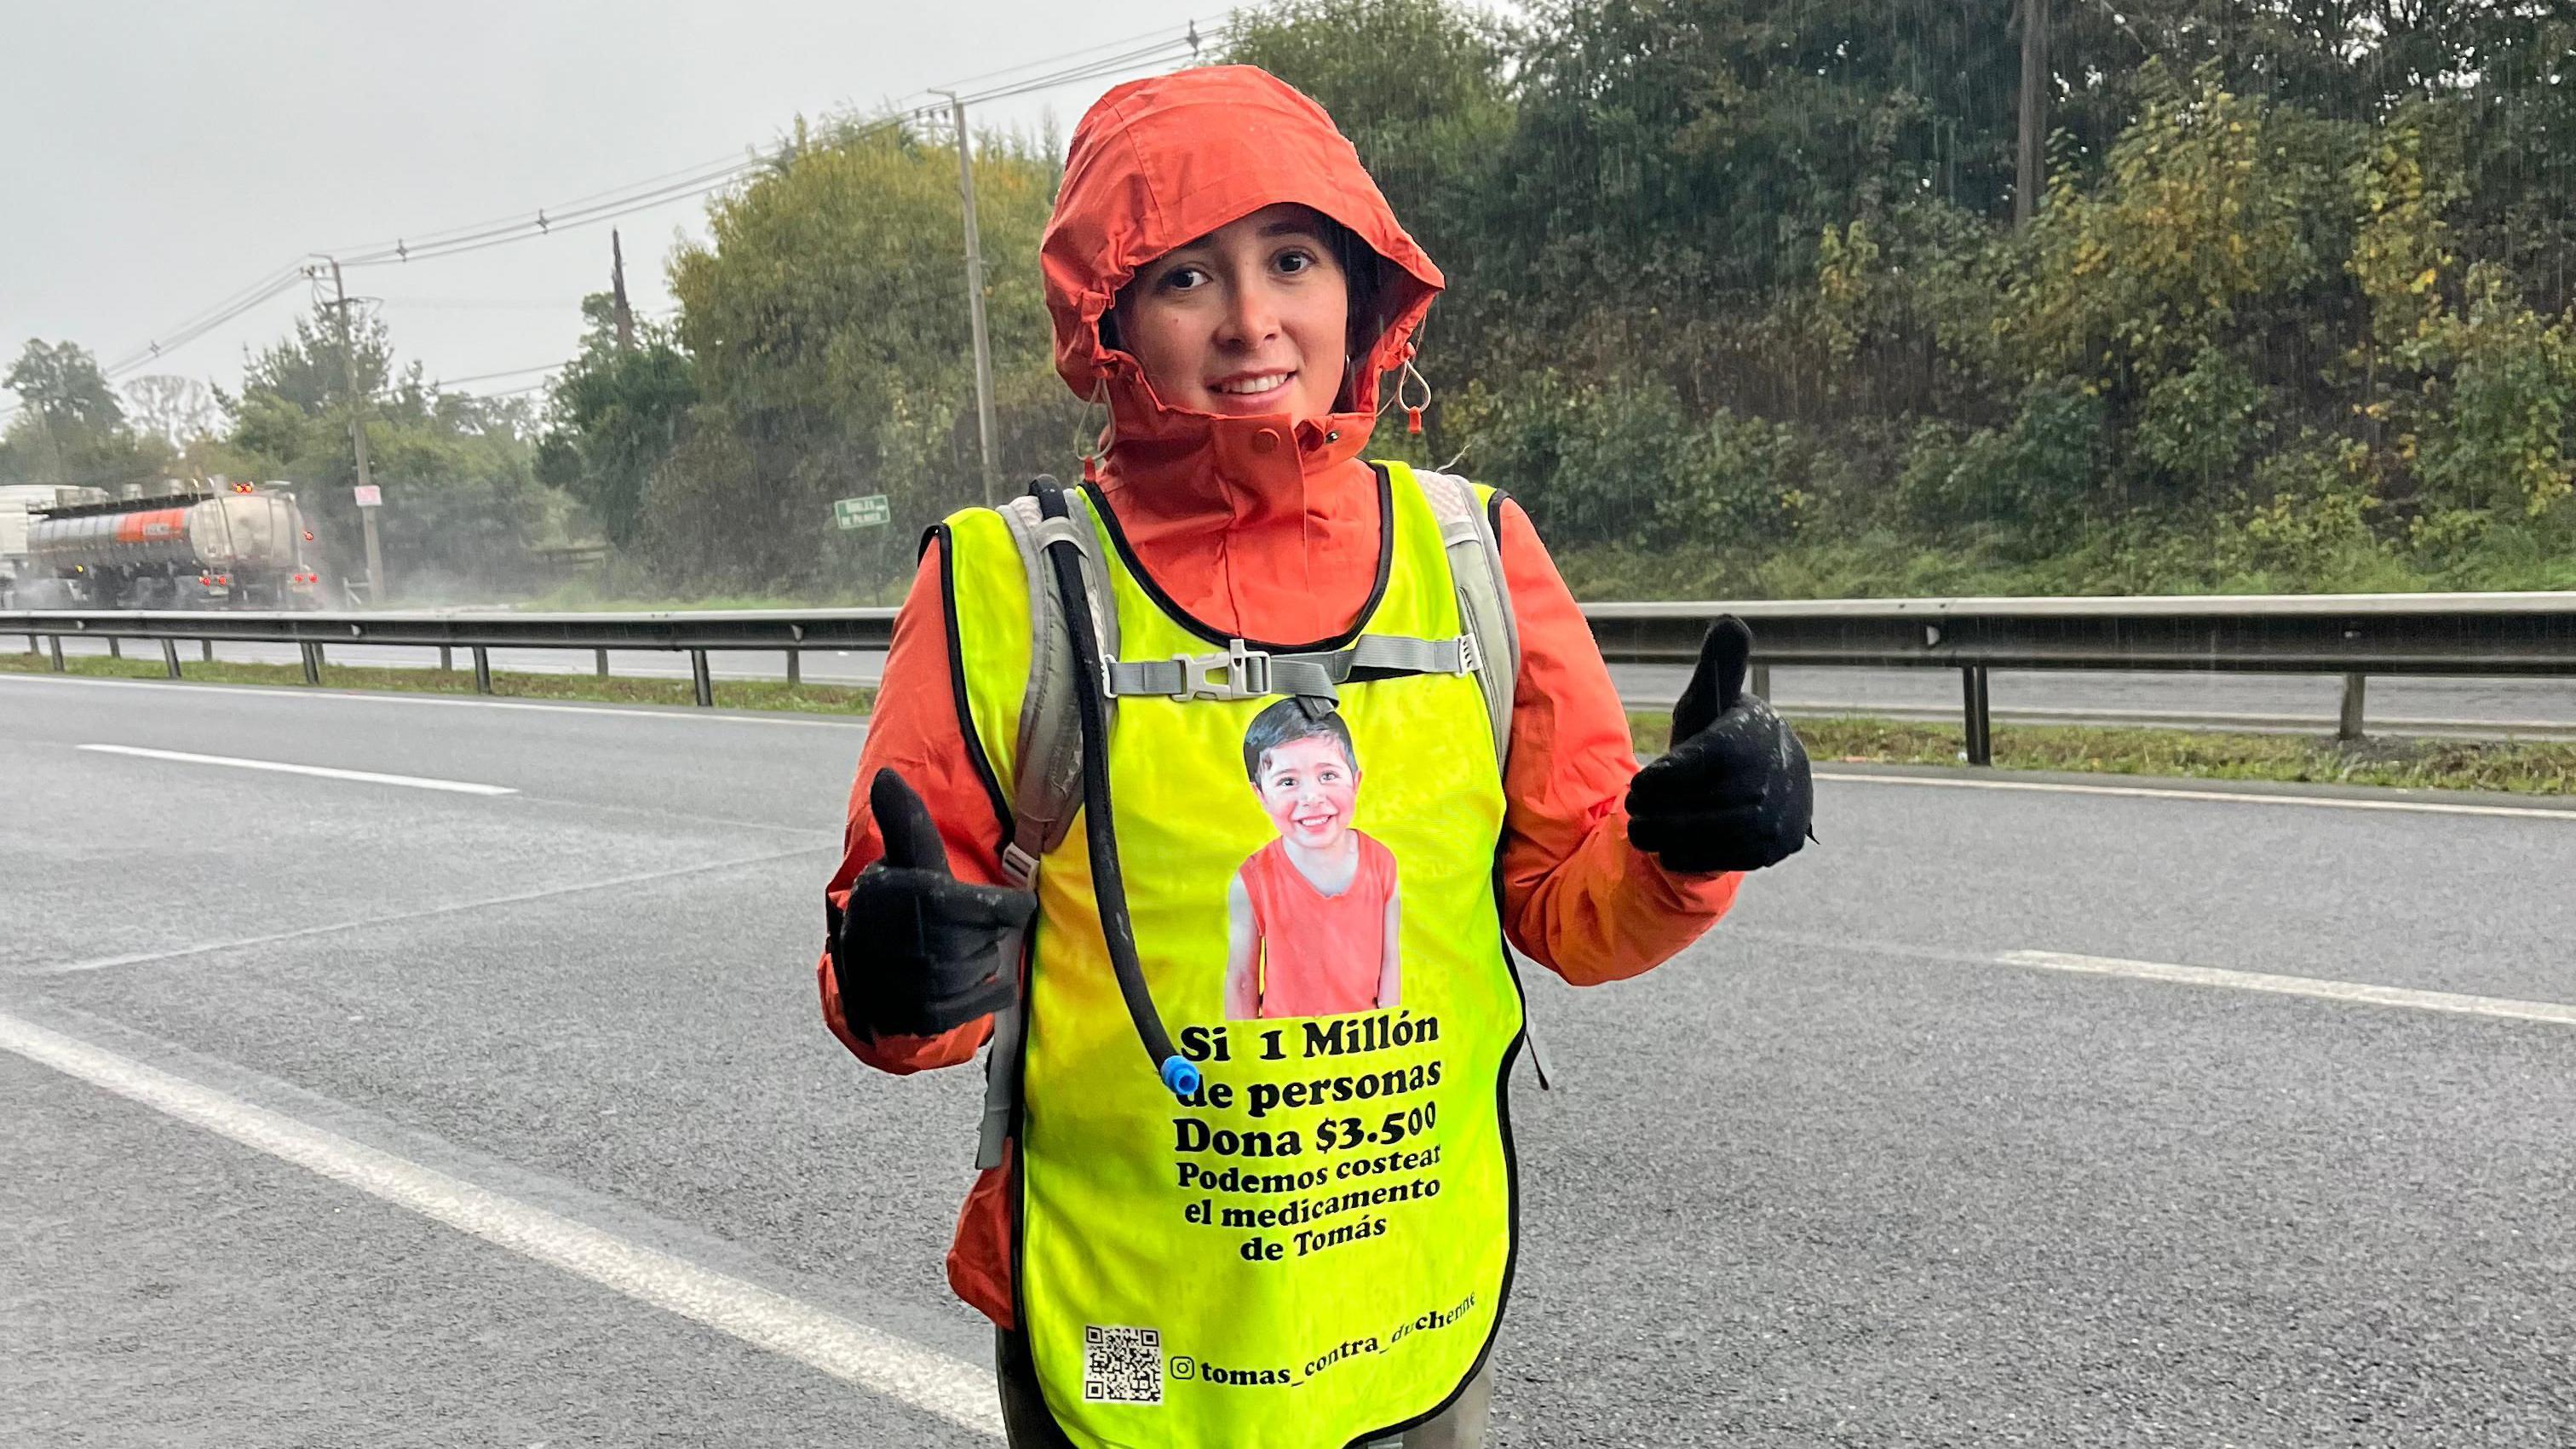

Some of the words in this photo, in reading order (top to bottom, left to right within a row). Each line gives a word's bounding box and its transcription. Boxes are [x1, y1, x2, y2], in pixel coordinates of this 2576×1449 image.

[1181, 1026, 1232, 1062] Si
[1259, 1030, 1287, 1061] 1
[1302, 1009, 1439, 1058] Millón
[1246, 1061, 1442, 1118] personas
[1172, 1118, 1303, 1157] Dona
[1315, 1101, 1437, 1154] $3.500
[1175, 1162, 1329, 1193] Podemos
[1335, 1144, 1441, 1180] costear
[1184, 1199, 1212, 1225] el
[1221, 1178, 1440, 1228] medicamento
[1239, 1236, 1285, 1262] de
[1293, 1214, 1387, 1256] Tomás
[1200, 1291, 1476, 1387] tomas_contra_duchenne
